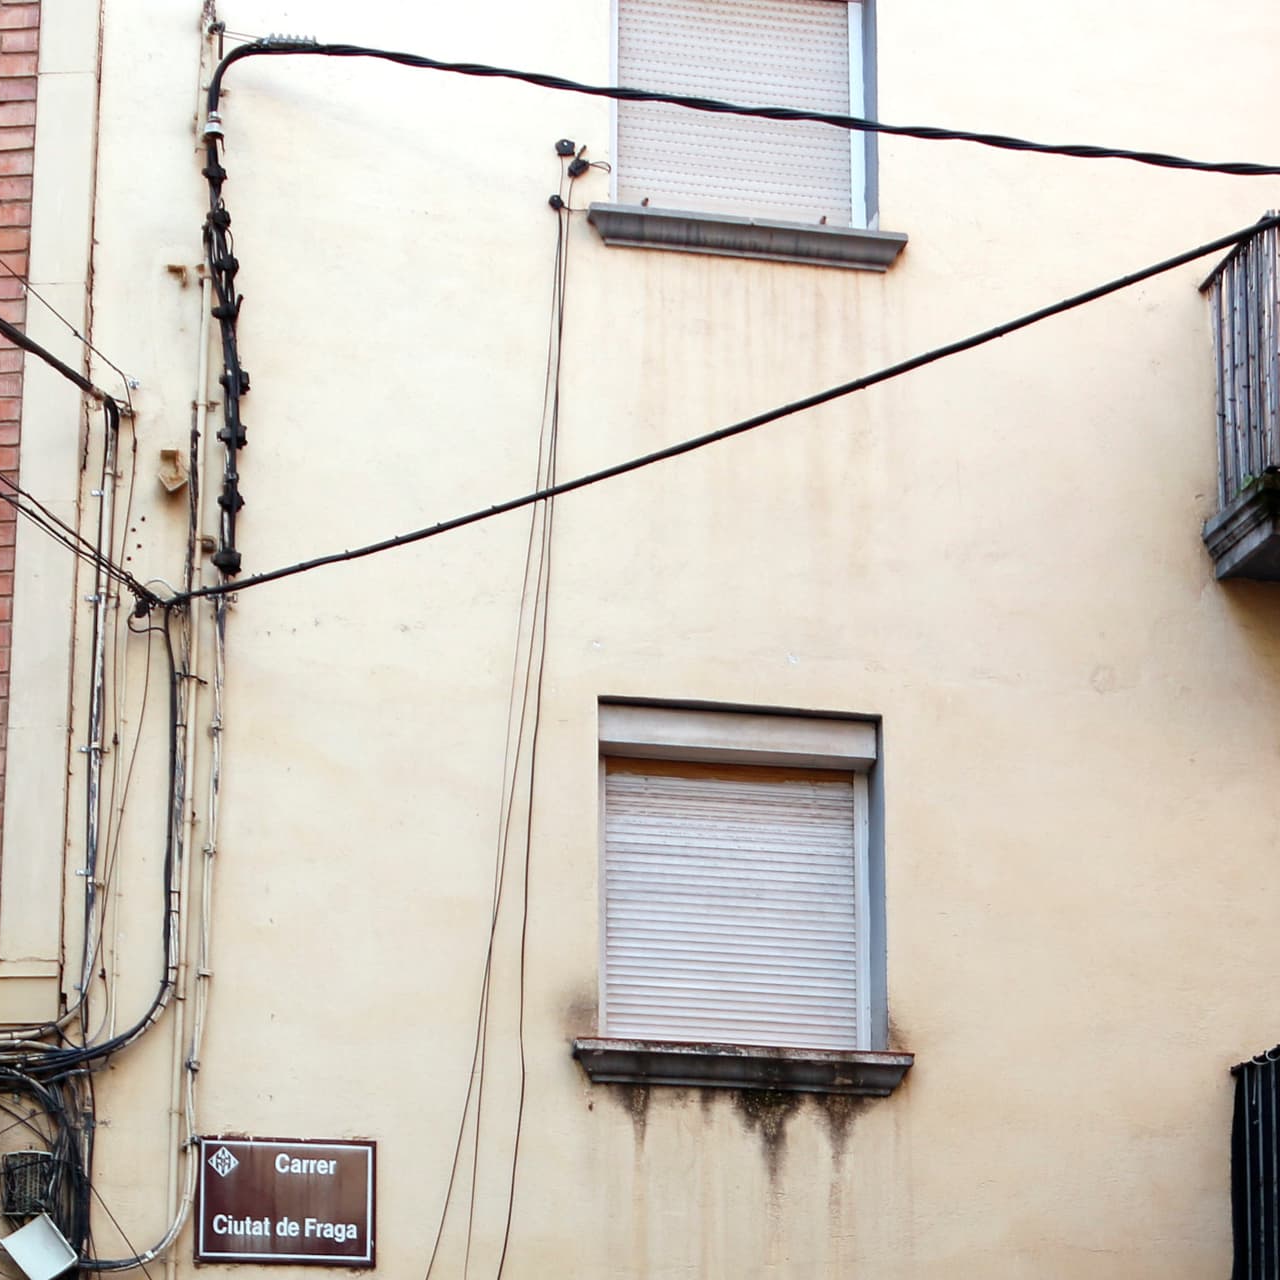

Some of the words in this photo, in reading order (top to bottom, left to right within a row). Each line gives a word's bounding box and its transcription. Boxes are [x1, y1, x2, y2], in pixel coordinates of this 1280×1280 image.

[275, 1153, 336, 1175] Carrer
[213, 1214, 271, 1237] Ciutat
[275, 1216, 300, 1237] de
[304, 1218, 358, 1243] Fraga
